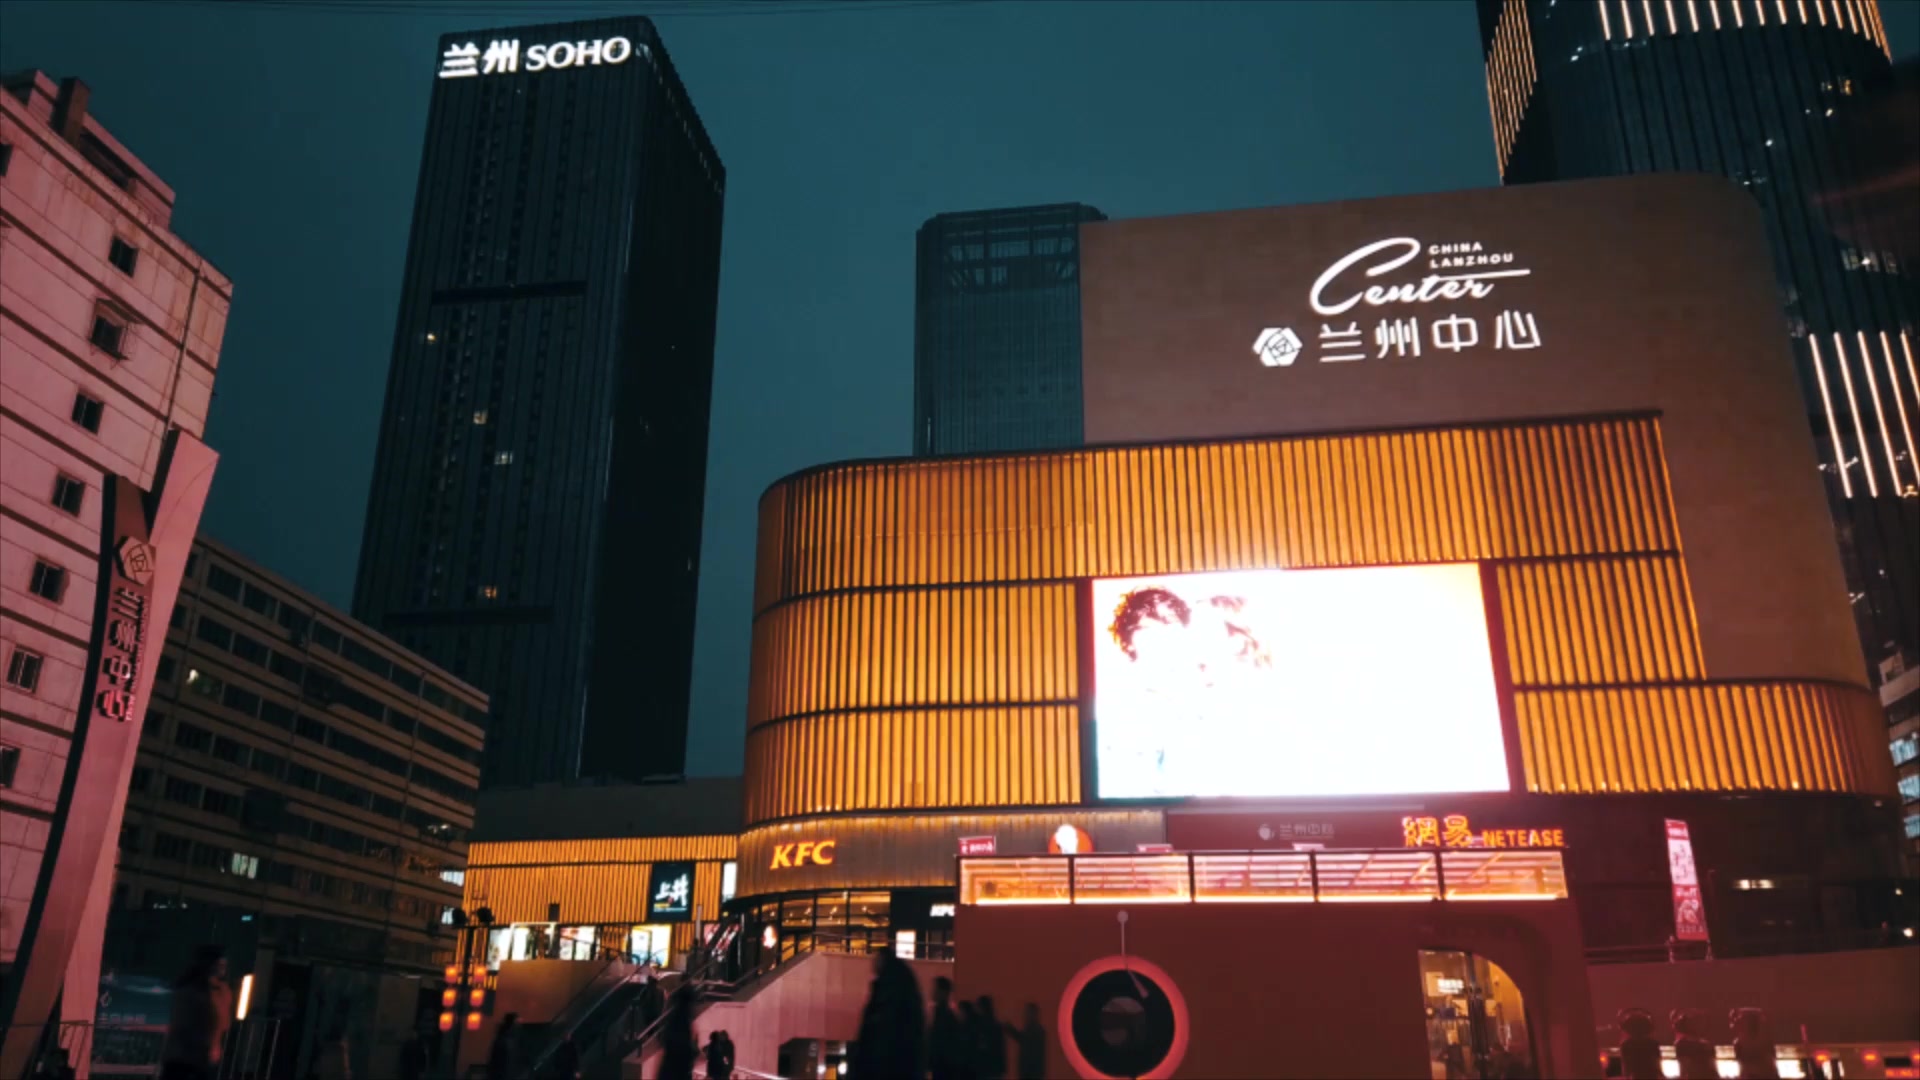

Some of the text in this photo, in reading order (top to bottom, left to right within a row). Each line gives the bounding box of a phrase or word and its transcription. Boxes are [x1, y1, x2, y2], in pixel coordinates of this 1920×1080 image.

[439, 36, 631, 78] 兰州 SOHO
[1429, 242, 1482, 255] CHINA
[1430, 253, 1513, 268] LANZHOU
[1310, 237, 1531, 315] Center
[1319, 309, 1541, 362] 兰州中心
[1482, 829, 1564, 847] NETEASE
[769, 840, 835, 870] KFC
